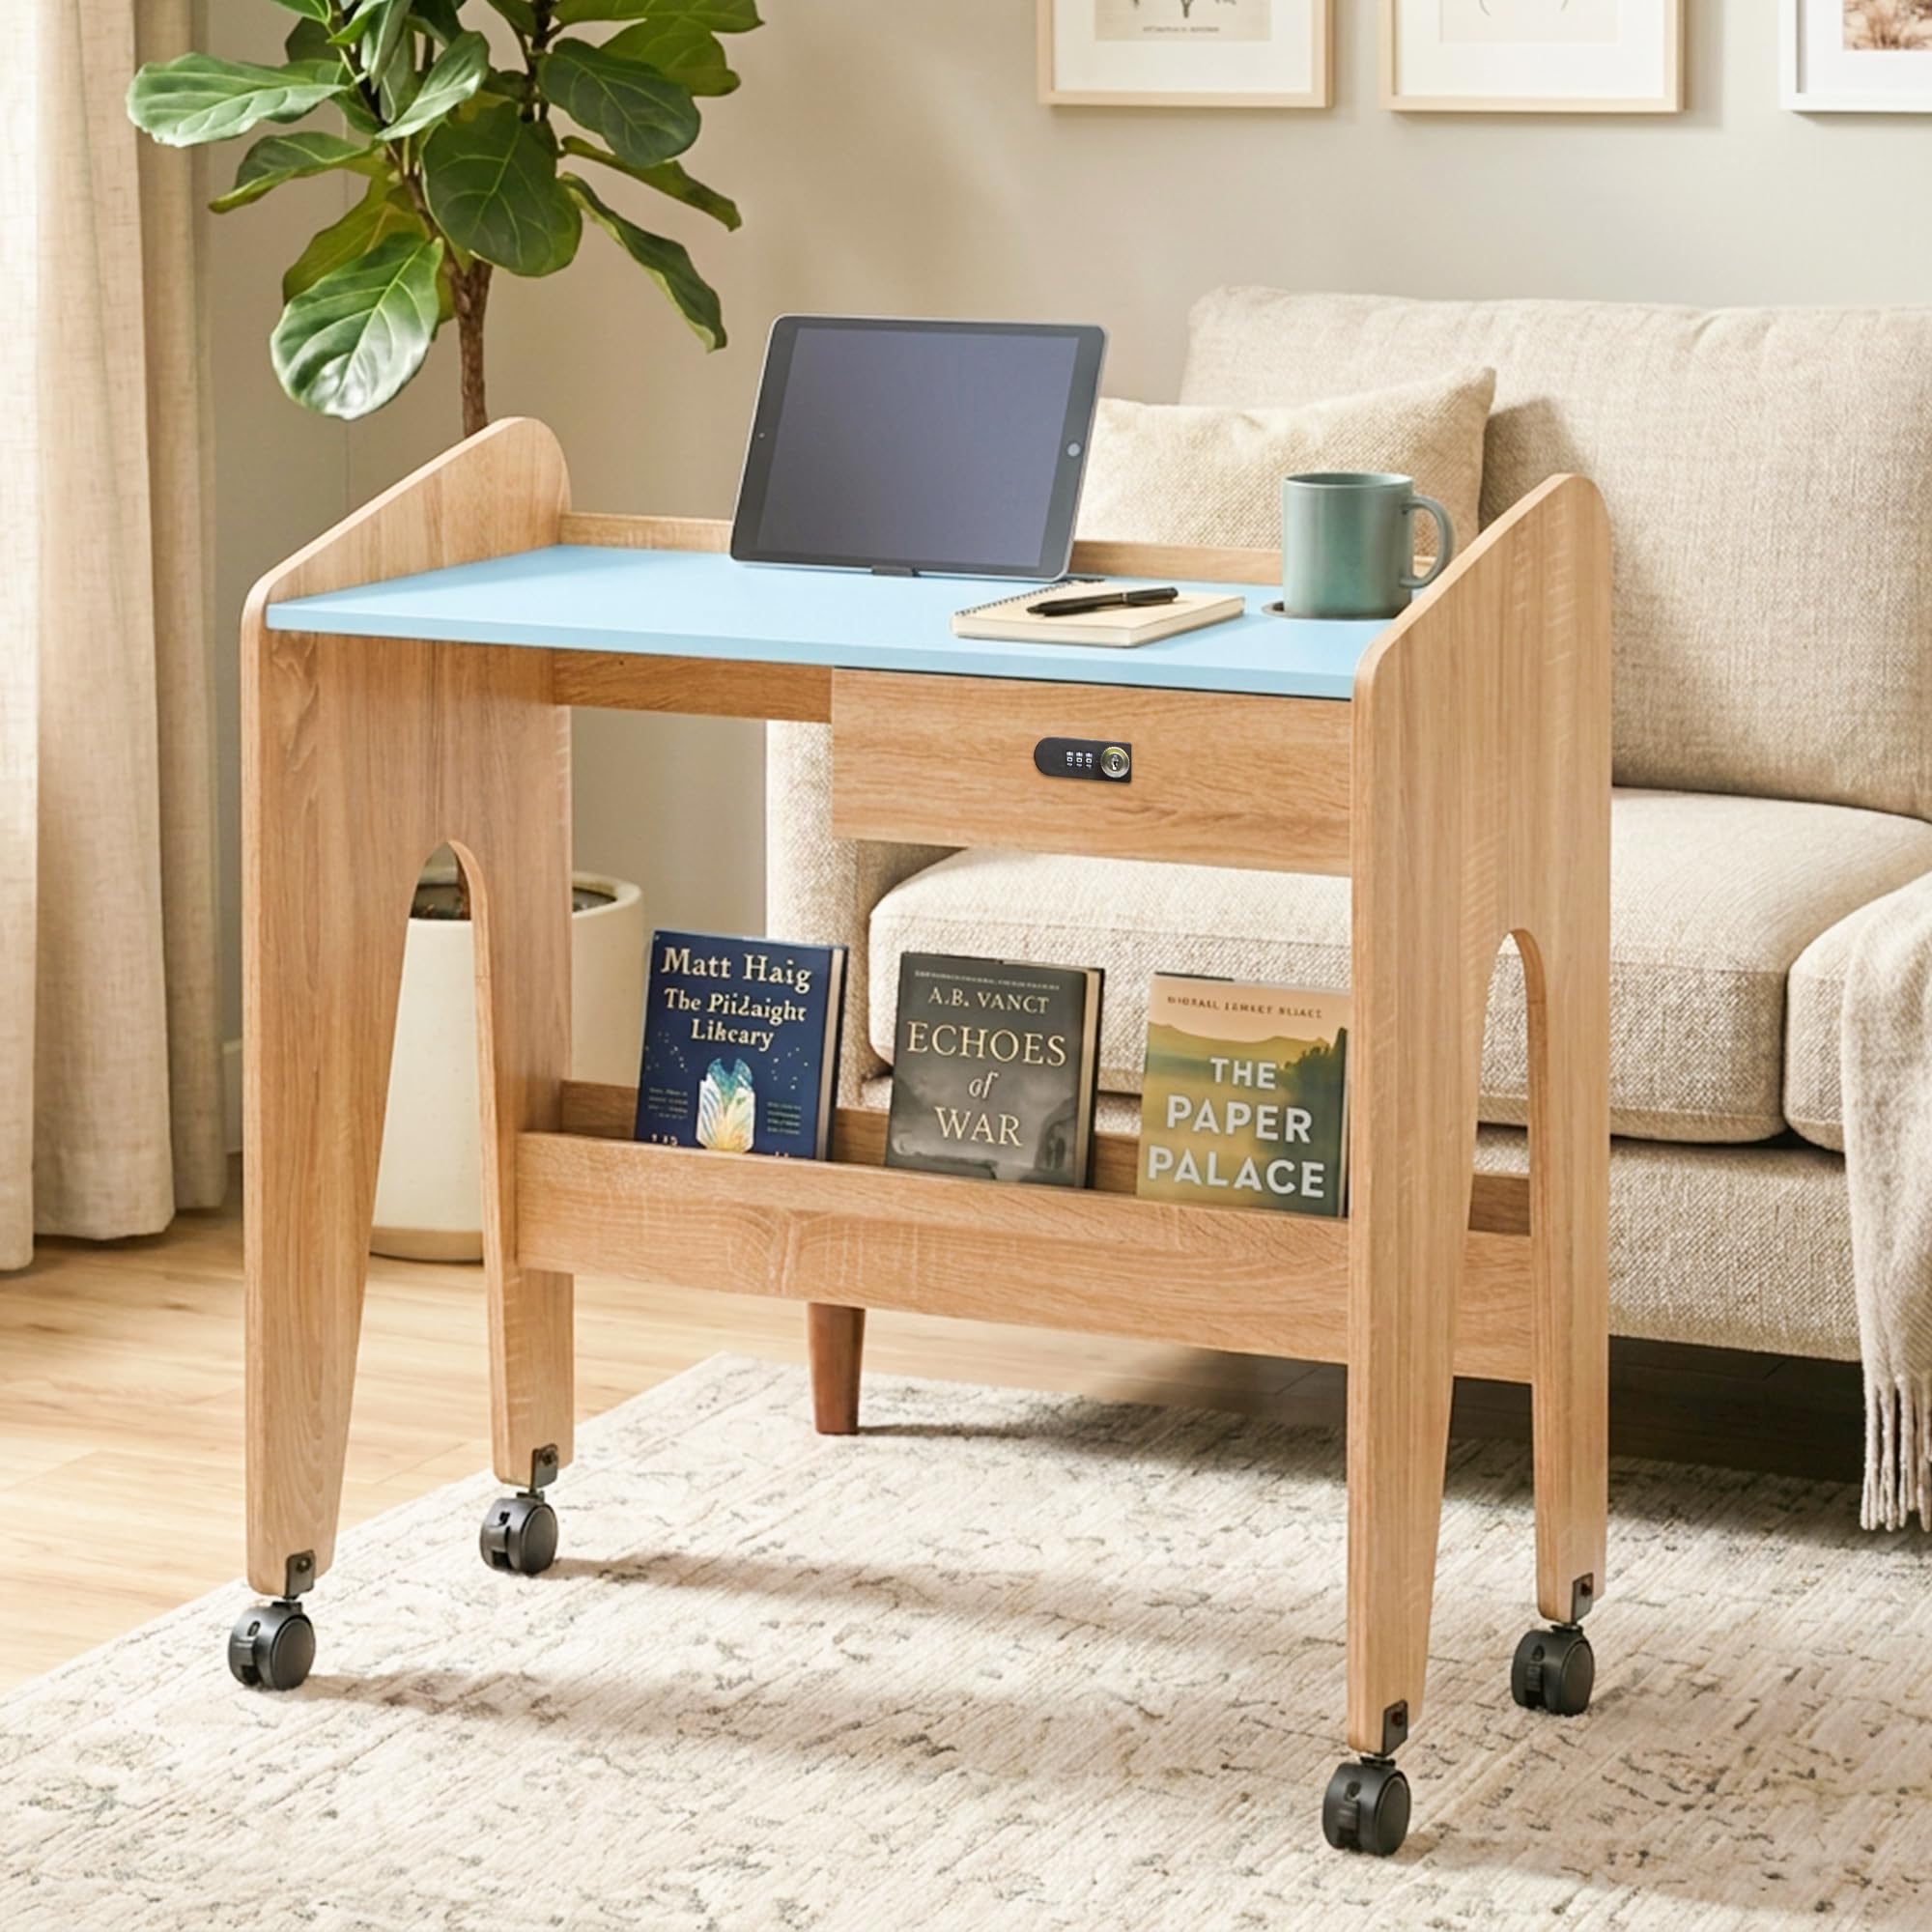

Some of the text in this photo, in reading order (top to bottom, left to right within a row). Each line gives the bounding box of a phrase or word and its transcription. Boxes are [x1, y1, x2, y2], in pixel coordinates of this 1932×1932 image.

[661, 947, 812, 994] Matt Haig
[664, 987, 701, 1011] The
[927, 986, 1050, 1014] A.B. VANCT
[906, 1020, 1067, 1066] ECHOES
[968, 1071, 999, 1098] of
[1209, 1057, 1277, 1090] THE
[934, 1106, 1023, 1147] WAR
[1166, 1094, 1313, 1144] PAPER
[1148, 1145, 1324, 1198] PALACE
